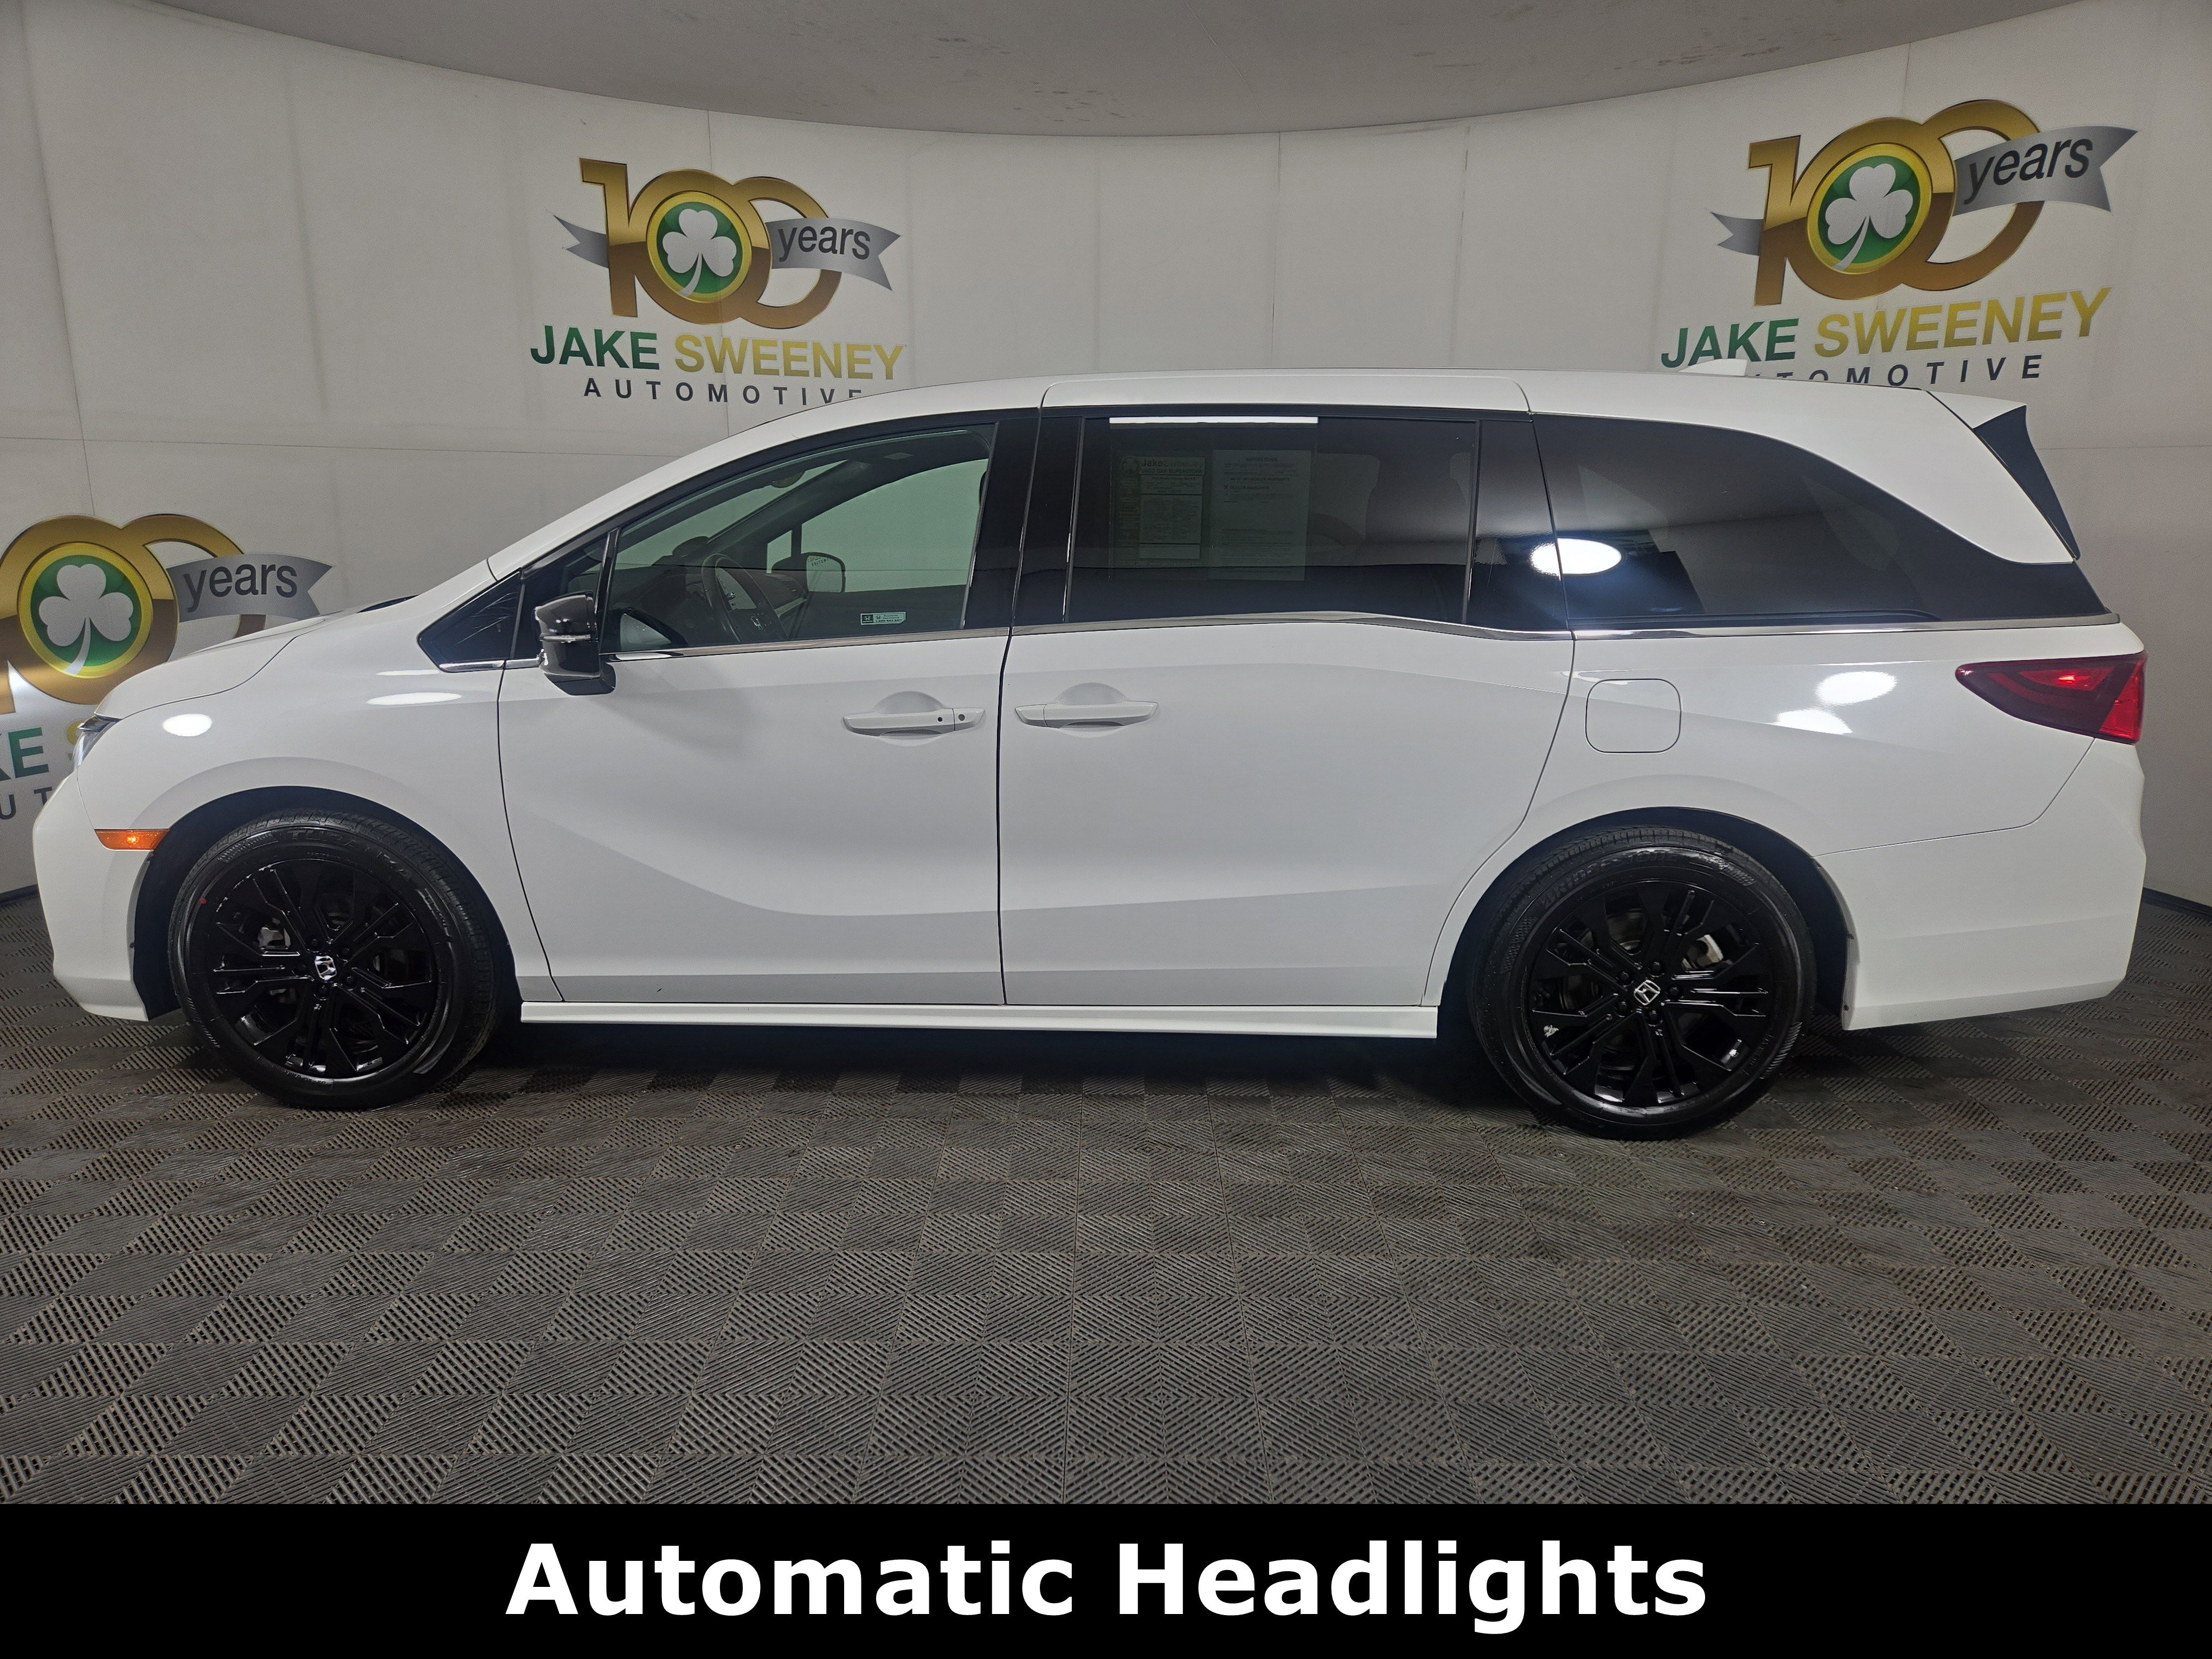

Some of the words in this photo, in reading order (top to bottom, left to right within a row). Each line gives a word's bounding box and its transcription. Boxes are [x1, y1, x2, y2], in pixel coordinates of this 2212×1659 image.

[1963, 138, 2094, 205] years
[777, 225, 871, 262] years
[530, 325, 660, 370] JAKE
[675, 334, 905, 381] SWEENEY
[1661, 318, 1799, 368] JAKE
[1815, 287, 2112, 358] SWEENEY
[183, 564, 298, 613] years
